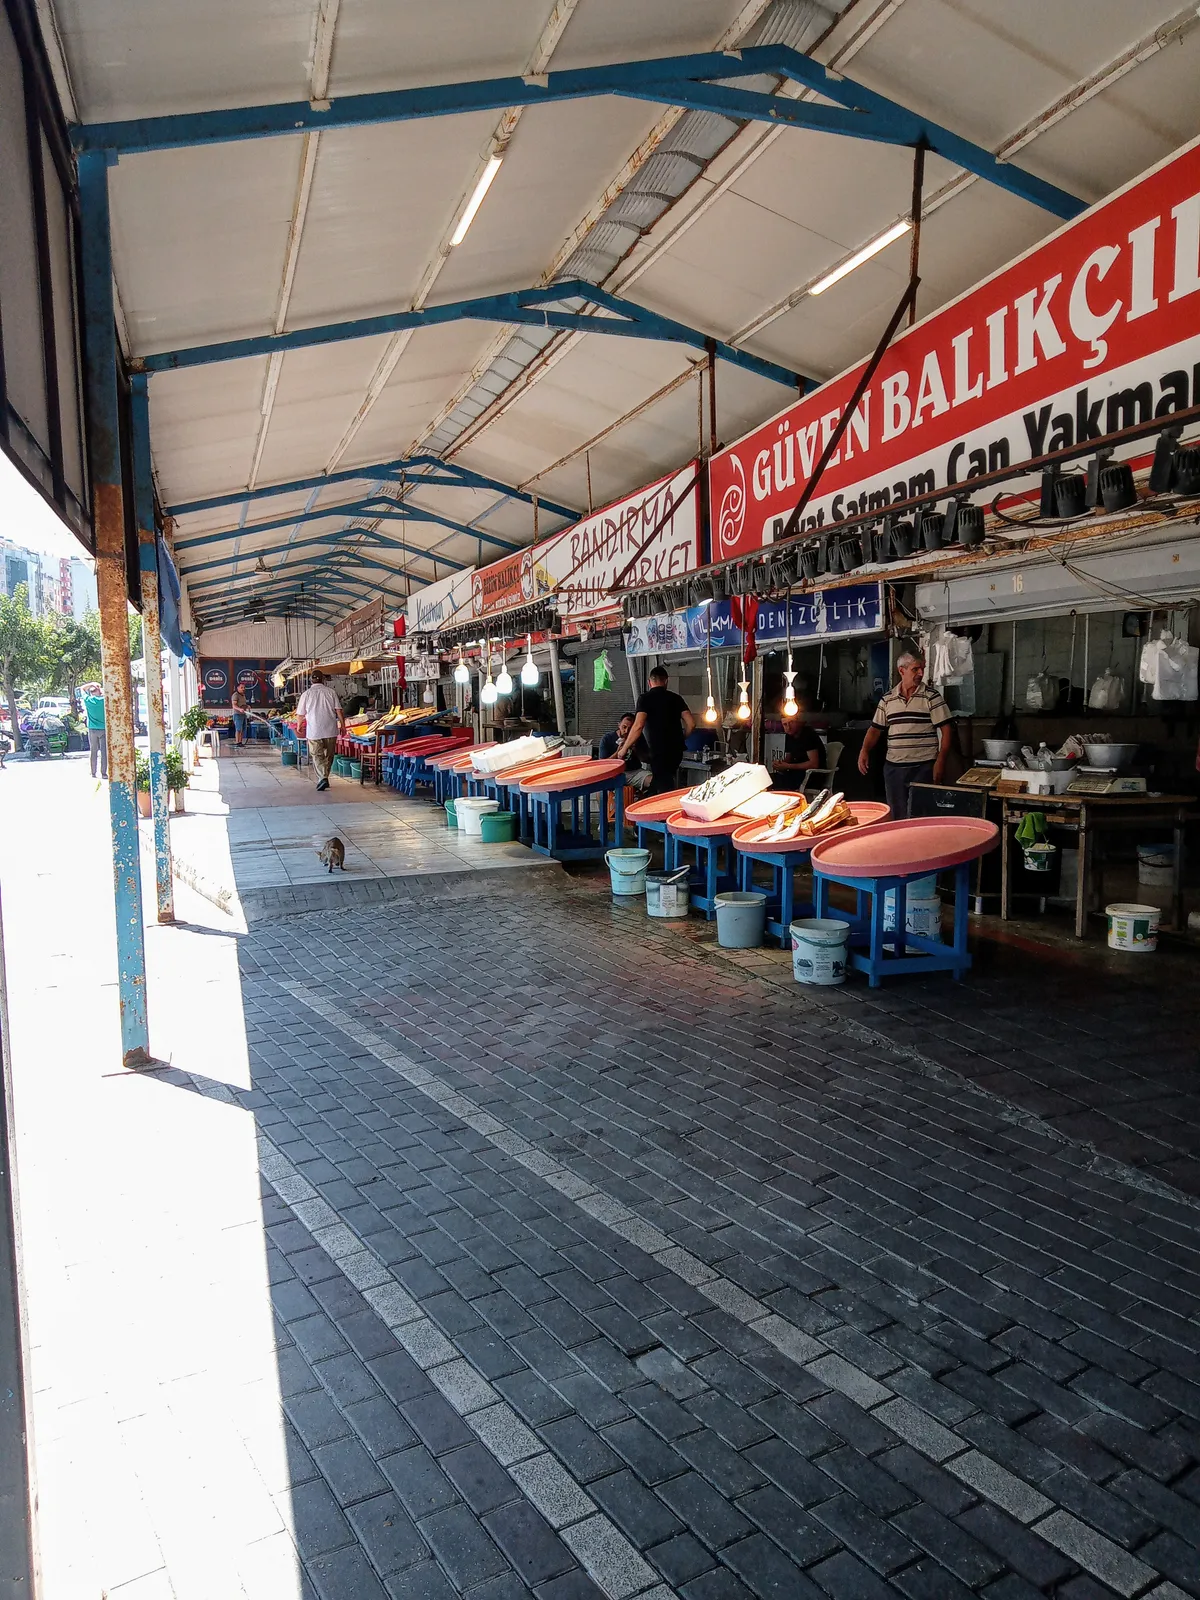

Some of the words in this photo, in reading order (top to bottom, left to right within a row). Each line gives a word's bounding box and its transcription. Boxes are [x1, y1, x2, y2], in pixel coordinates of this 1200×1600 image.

[752, 389, 872, 501] GÜVEN
[772, 506, 825, 543] Byat
[831, 468, 936, 526] Satmam
[946, 437, 1010, 493] Can
[1023, 361, 1200, 472] Yakma
[571, 485, 674, 575] BANDIRMA
[567, 571, 608, 613] BALIK
[758, 597, 866, 630] DENİZCLİK
[1011, 574, 1023, 593] 16
